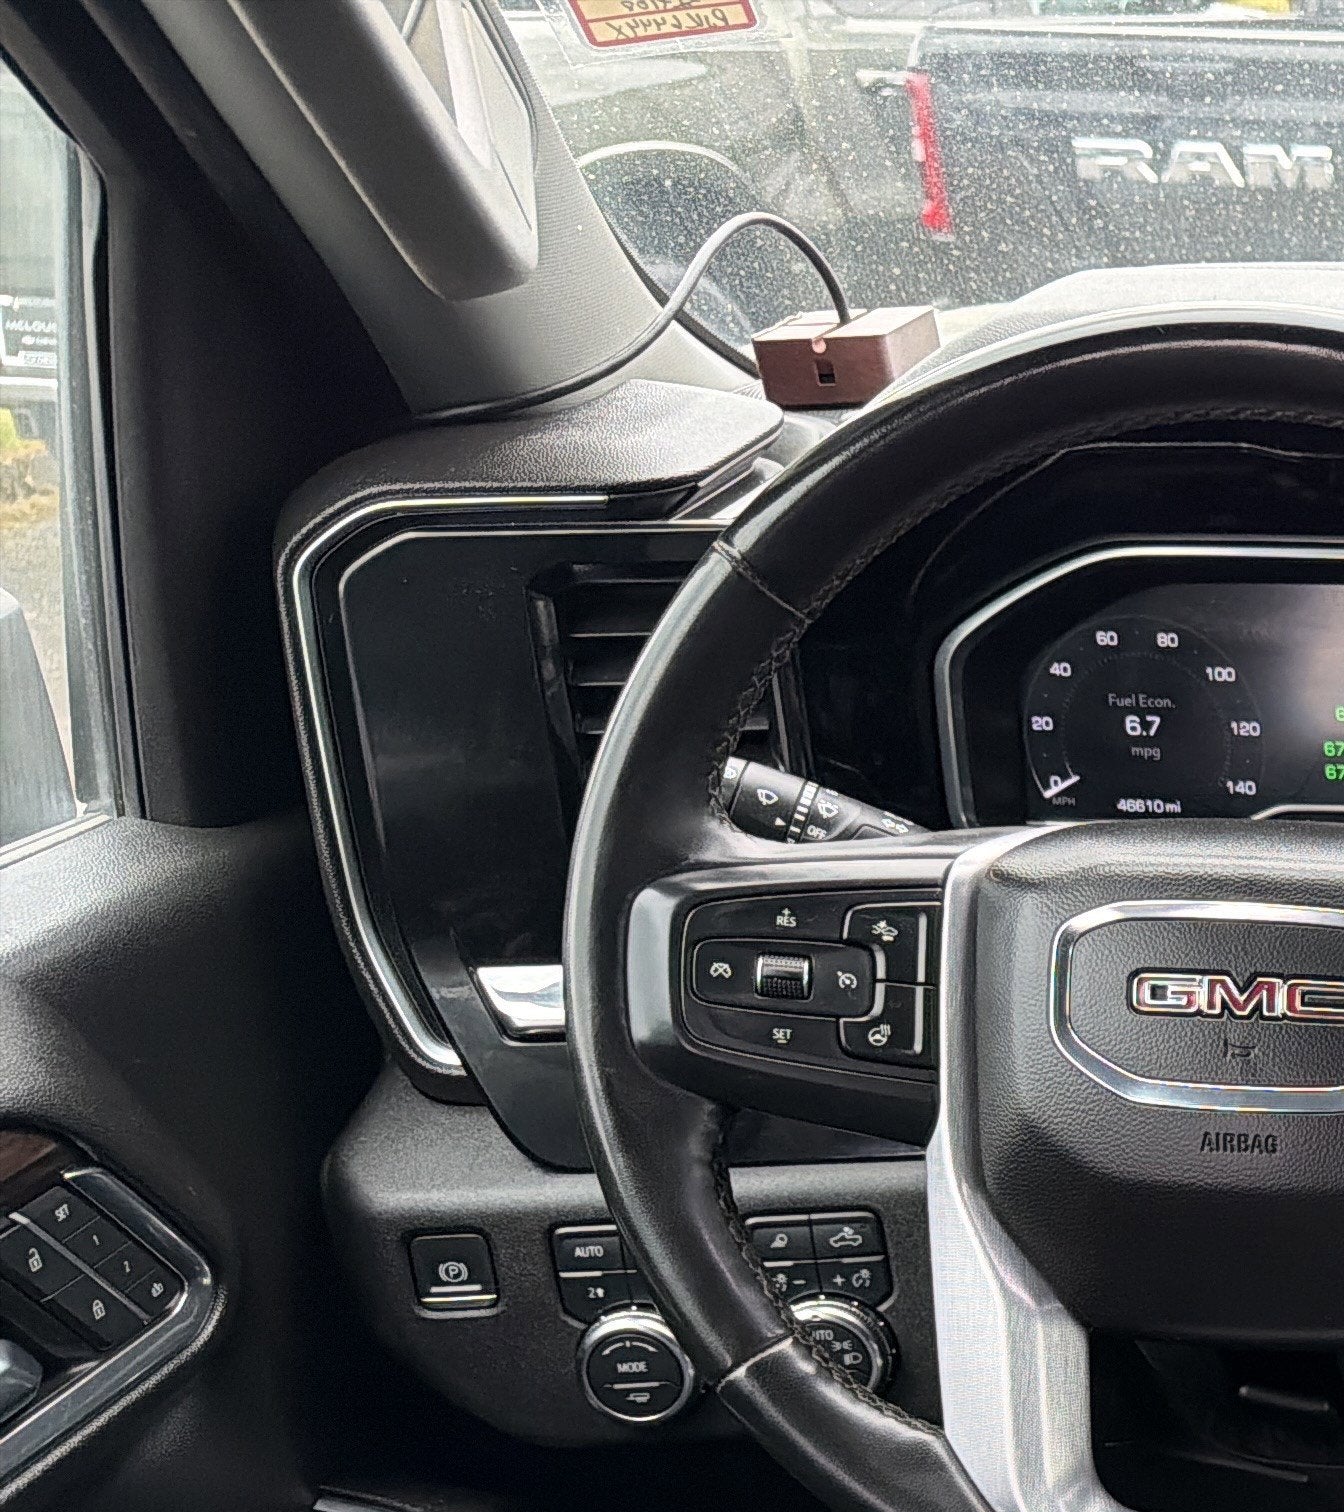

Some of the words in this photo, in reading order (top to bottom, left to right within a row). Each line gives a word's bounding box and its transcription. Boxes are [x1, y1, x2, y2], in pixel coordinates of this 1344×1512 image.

[1071, 138, 1334, 190] RAM
[1096, 631, 1118, 646] 60
[1156, 633, 1178, 648] 80
[1050, 662, 1072, 677] 40
[1205, 667, 1236, 682] 100
[1108, 693, 1136, 708] Fuel
[1139, 694, 1176, 708] Econ.
[1031, 716, 1054, 731] 20
[1124, 714, 1161, 737] 6.7
[1230, 720, 1261, 737] 120
[1131, 746, 1161, 761] mpg
[1226, 780, 1257, 796] 140
[776, 916, 797, 928] RES
[772, 1028, 793, 1039] SET
[1199, 1131, 1278, 1154] AIRBAG
[55, 1203, 70, 1222] SET
[574, 1245, 604, 1258] AUTO
[616, 1360, 649, 1374] MODE
